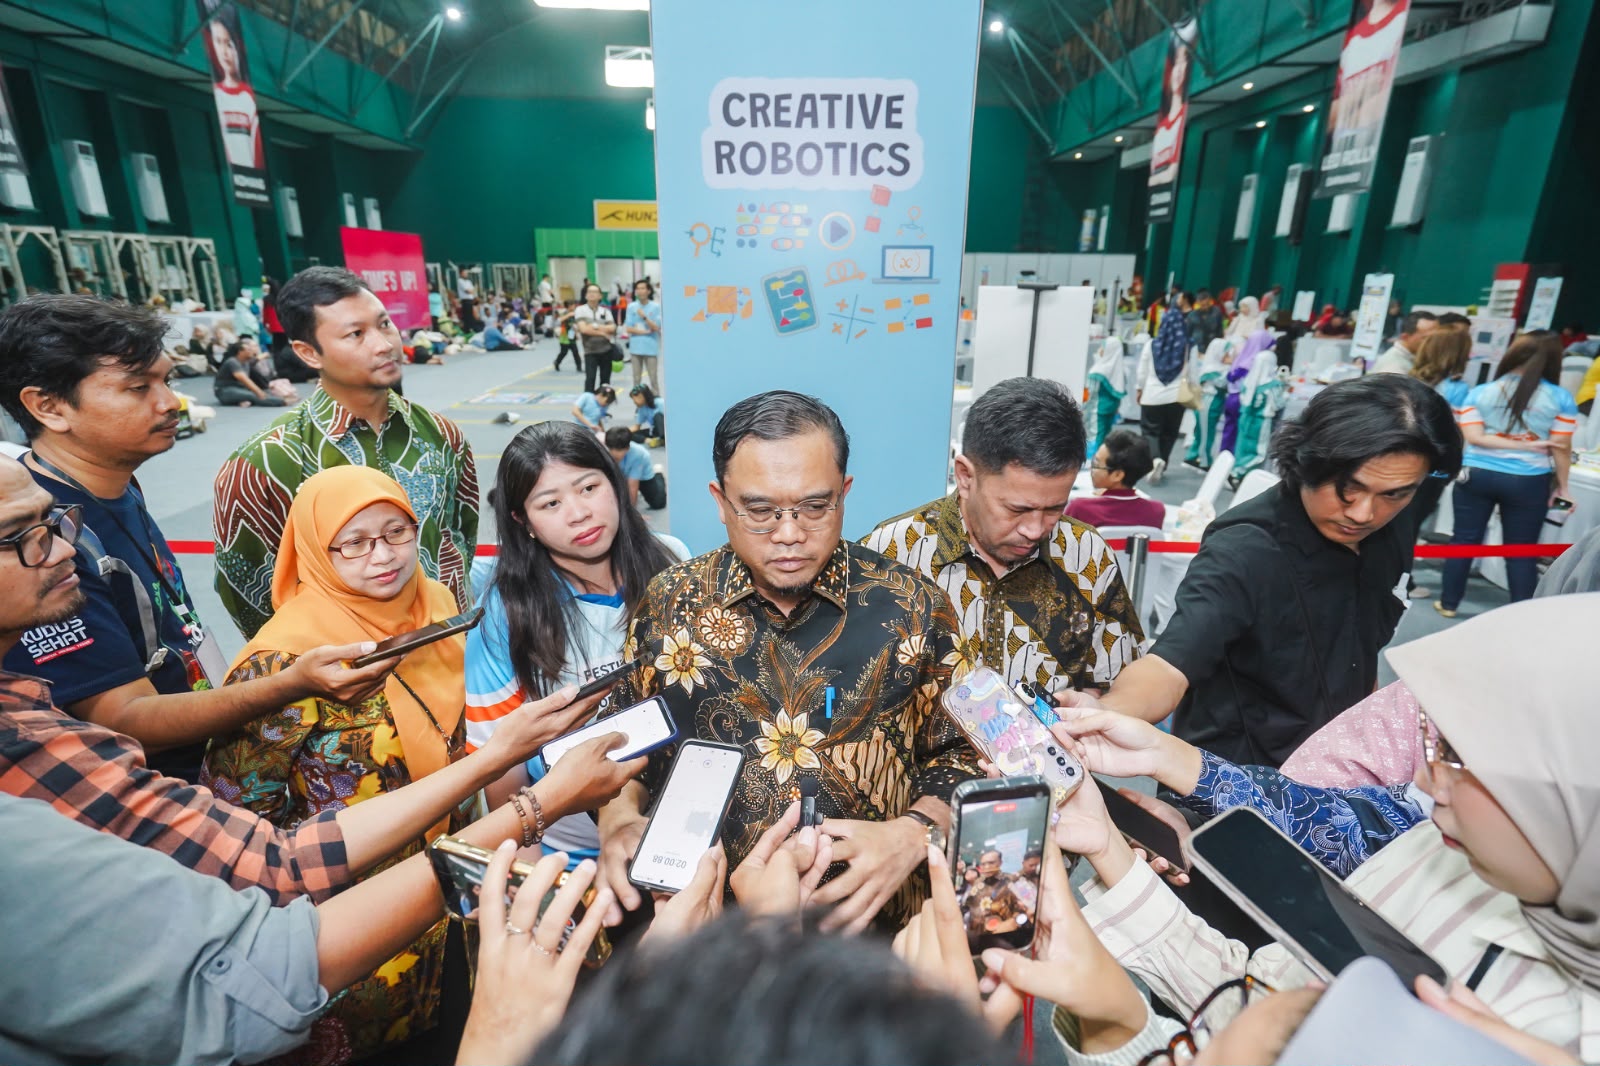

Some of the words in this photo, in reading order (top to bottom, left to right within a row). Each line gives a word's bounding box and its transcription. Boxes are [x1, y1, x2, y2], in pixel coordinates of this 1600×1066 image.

[721, 92, 904, 130] CREATIVE
[714, 140, 911, 177] ROBOTICS
[20, 615, 84, 647] KUDUS
[27, 626, 87, 659] SEHAT
